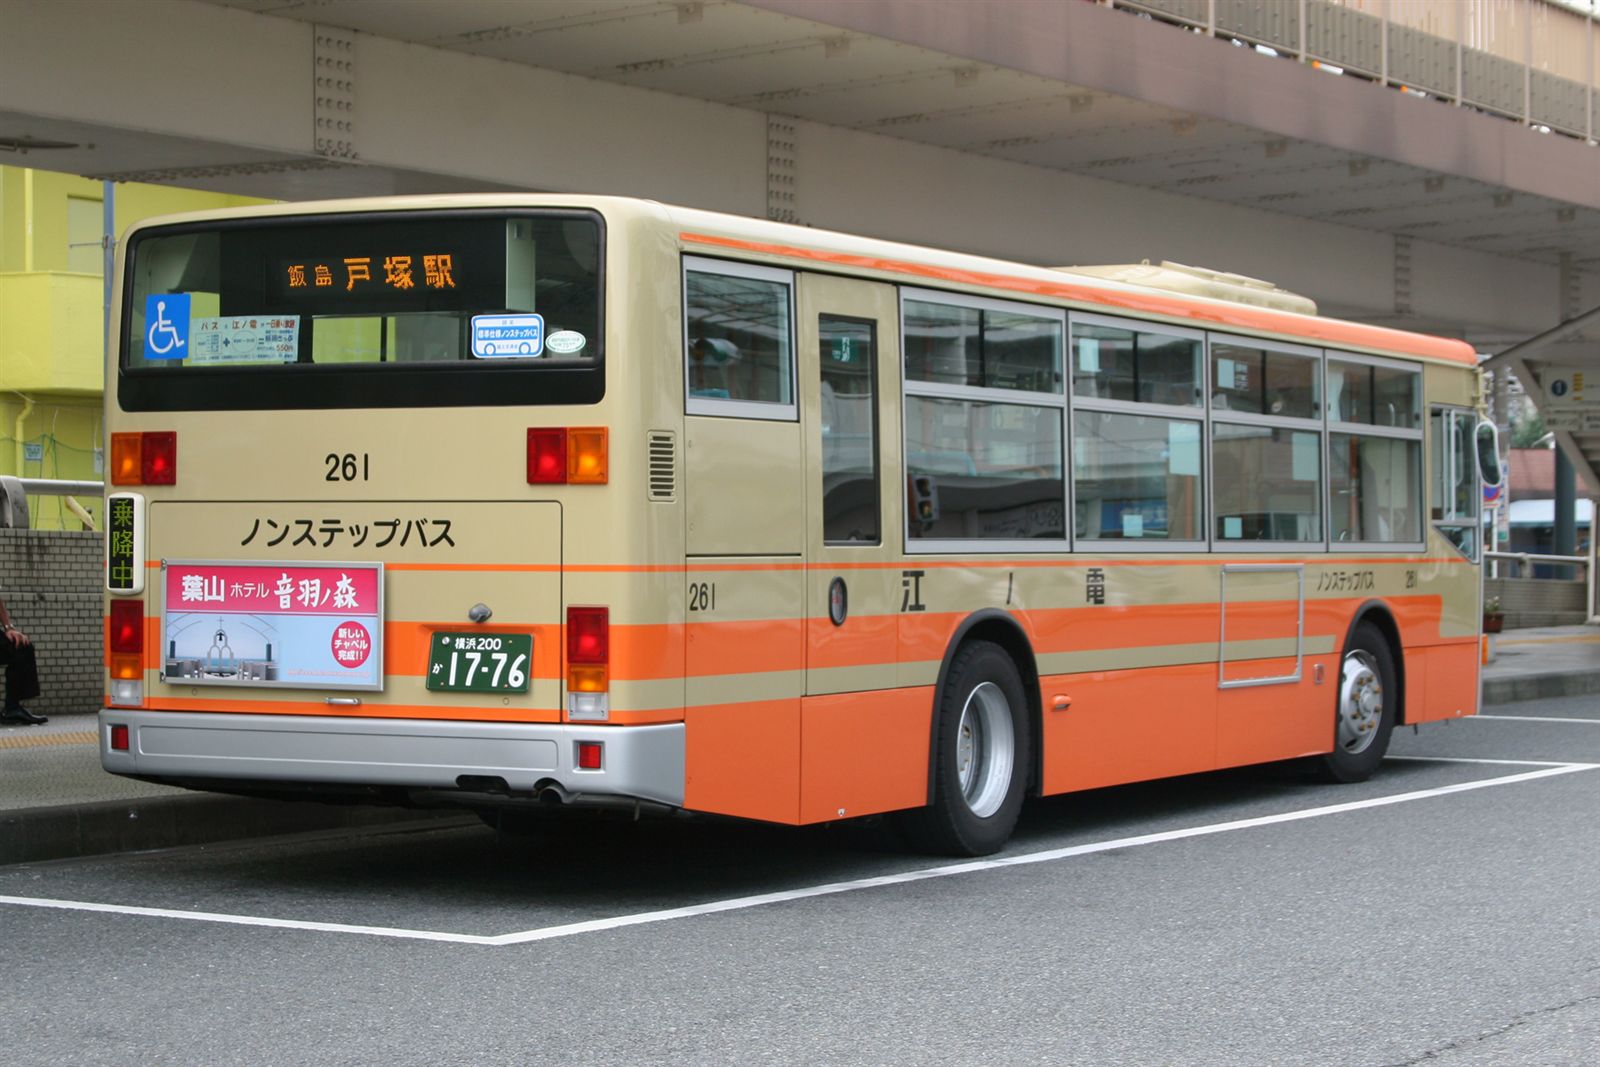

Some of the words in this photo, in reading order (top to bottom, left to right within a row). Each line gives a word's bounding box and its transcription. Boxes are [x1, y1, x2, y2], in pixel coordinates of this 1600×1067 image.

[287, 264, 333, 287] 飯島
[343, 254, 456, 291] 戸塚駅
[325, 453, 369, 481] 261
[112, 499, 134, 590] 乗降中
[241, 518, 455, 548] ノンステップバス
[181, 575, 225, 602] 葉山
[229, 582, 270, 599] ホテル
[274, 573, 360, 609] 音羽ノ森
[1317, 570, 1375, 592] ノンステップバス
[689, 582, 715, 612] 261
[334, 639, 369, 650] チャペル
[338, 627, 365, 639] 新しい
[432, 662, 444, 675] か
[448, 651, 527, 688] 17-76
